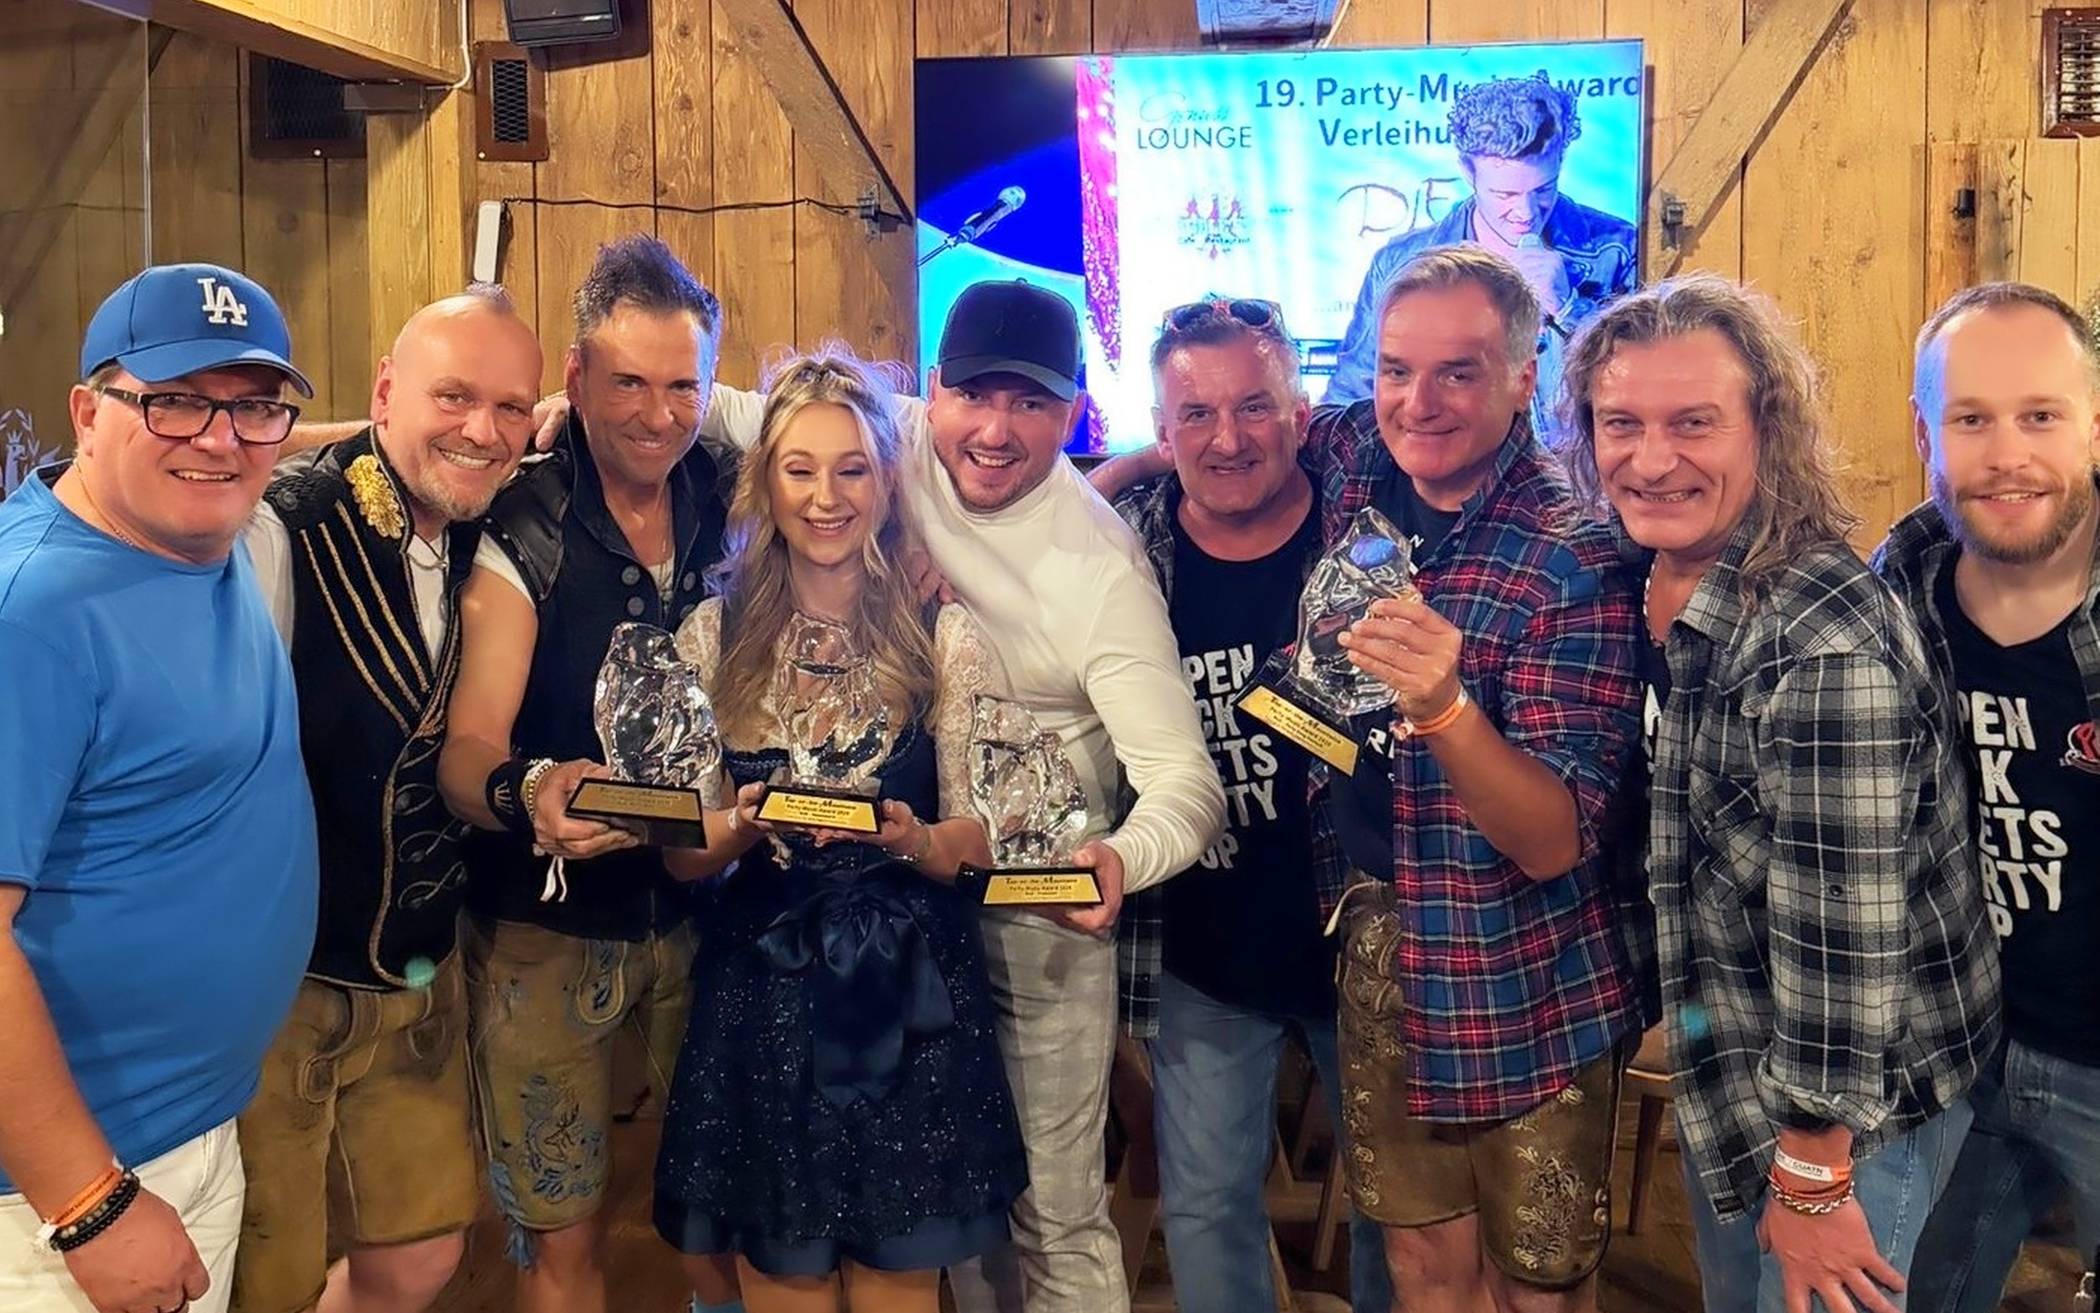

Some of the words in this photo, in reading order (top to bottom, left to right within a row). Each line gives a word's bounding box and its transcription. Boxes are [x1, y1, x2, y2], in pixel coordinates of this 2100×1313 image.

[1255, 79, 1304, 107] 19.
[1138, 126, 1252, 149] LOUNGE
[1319, 118, 1452, 147] Verleihu
[197, 277, 248, 327] LA
[1181, 643, 1255, 697] PEN
[1979, 803, 2068, 858] ETS
[1979, 851, 2062, 911] RTY
